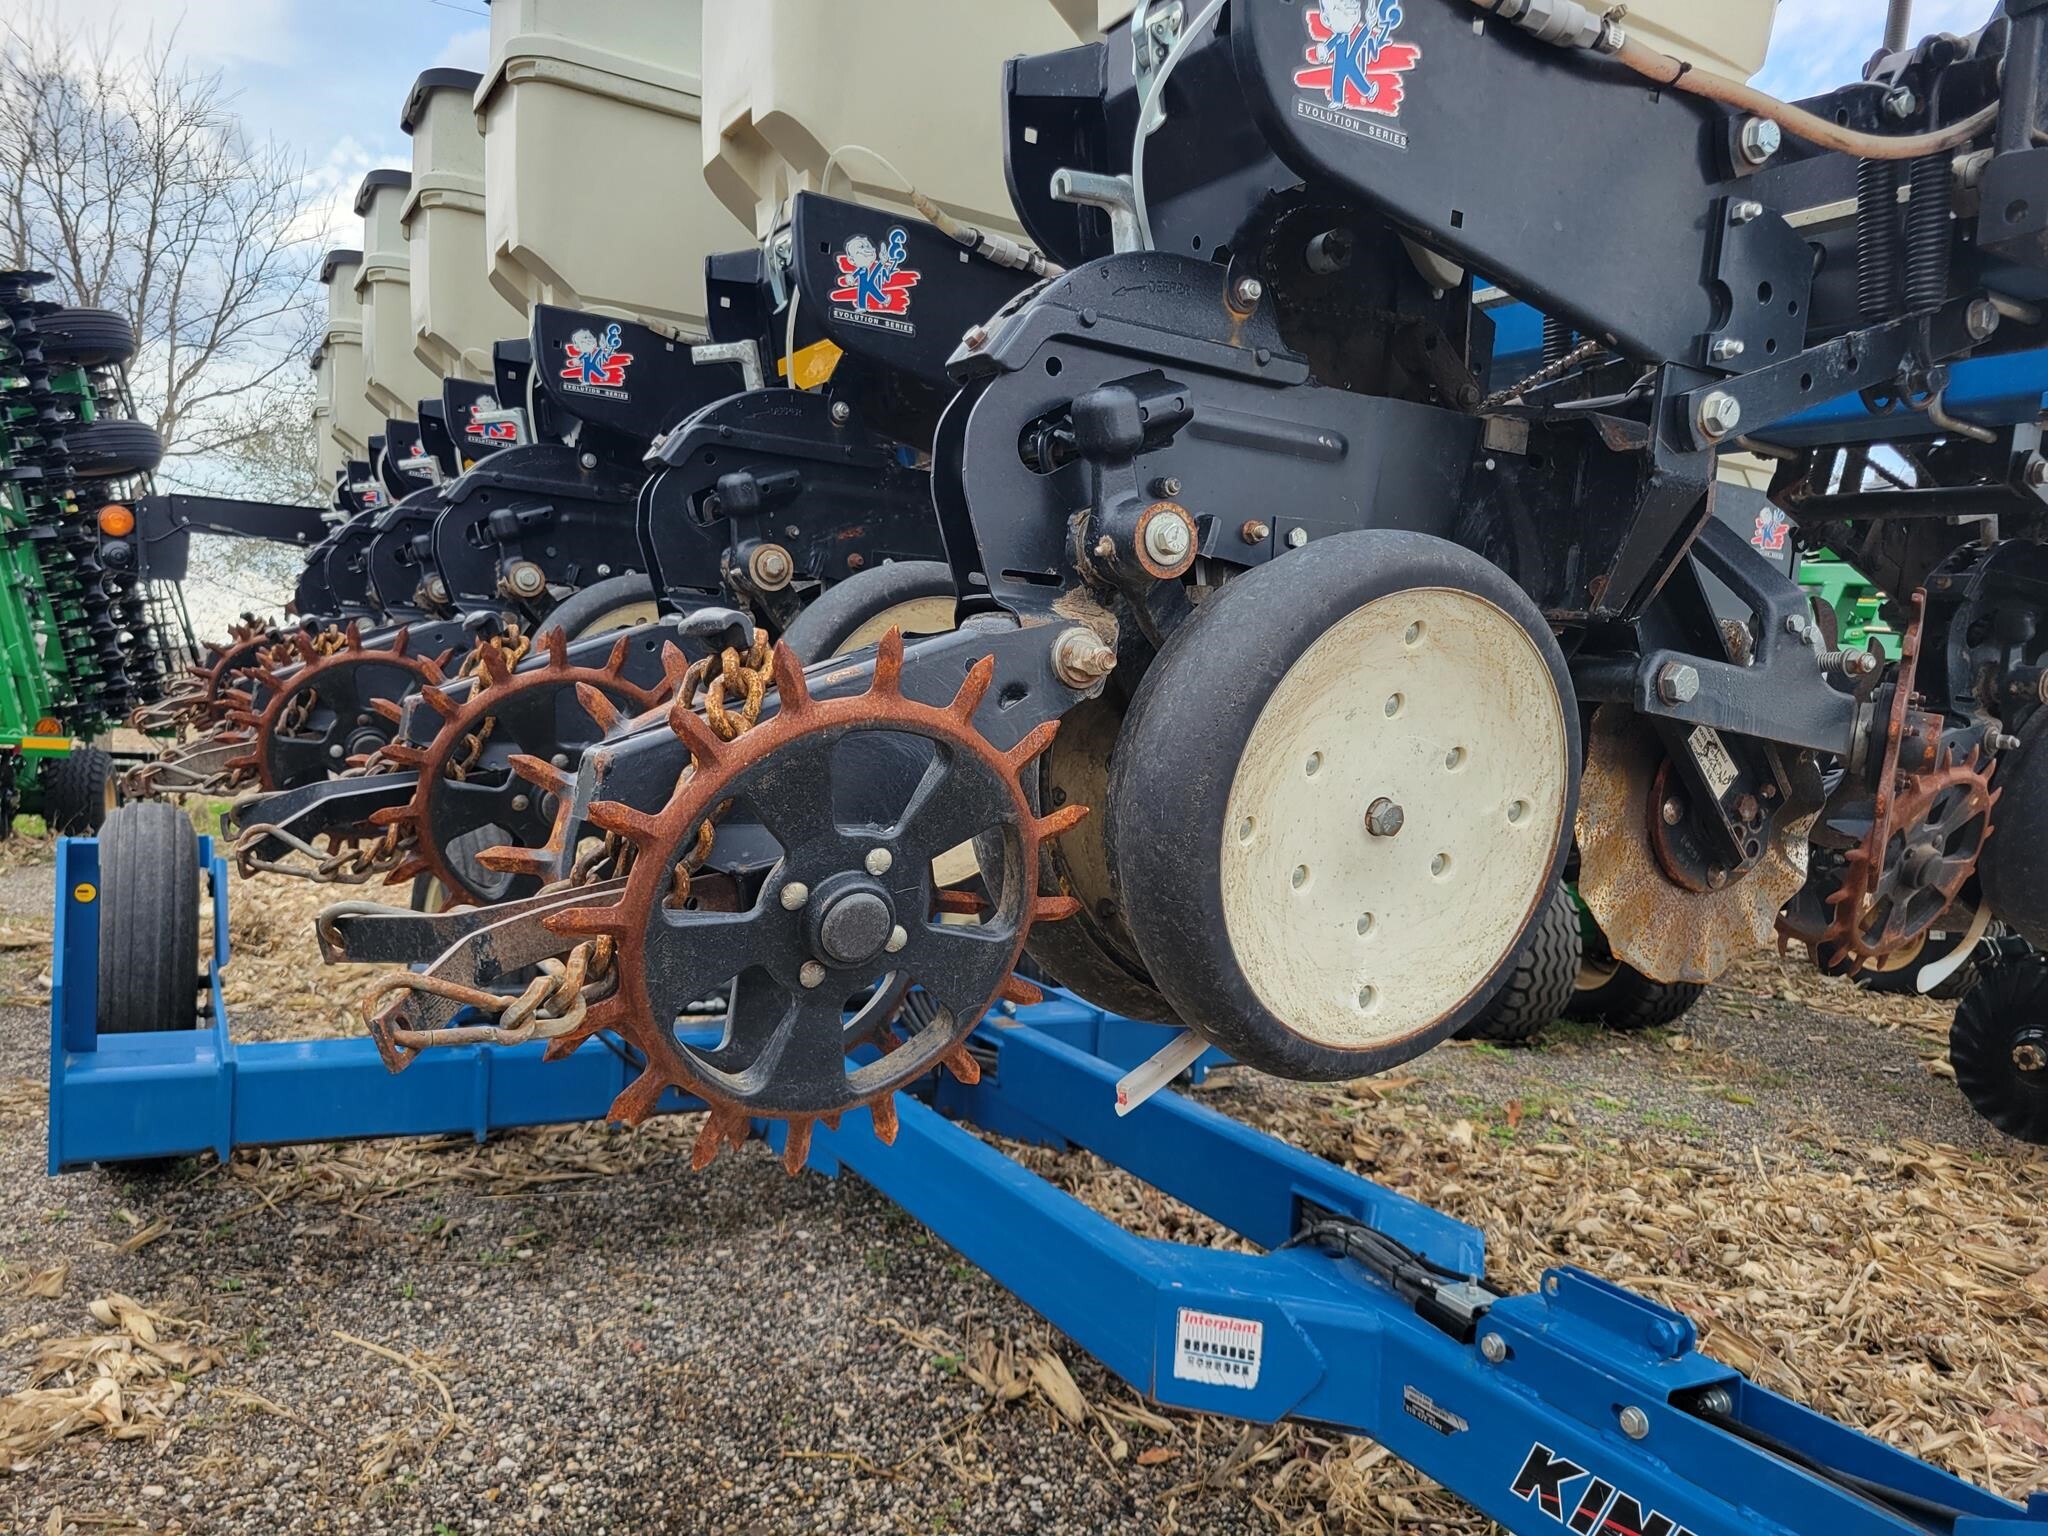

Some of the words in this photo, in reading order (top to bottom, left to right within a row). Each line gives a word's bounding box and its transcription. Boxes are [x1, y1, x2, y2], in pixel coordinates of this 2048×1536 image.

[1298, 103, 1360, 131] EVOLUTION
[1368, 126, 1407, 146] SERIES
[833, 310, 879, 325] EVOLUTION
[885, 320, 913, 332] SERIES
[563, 383, 601, 395] EVOLUTION
[1184, 1311, 1258, 1335] Interplant
[1510, 1441, 1698, 1536] KIN
